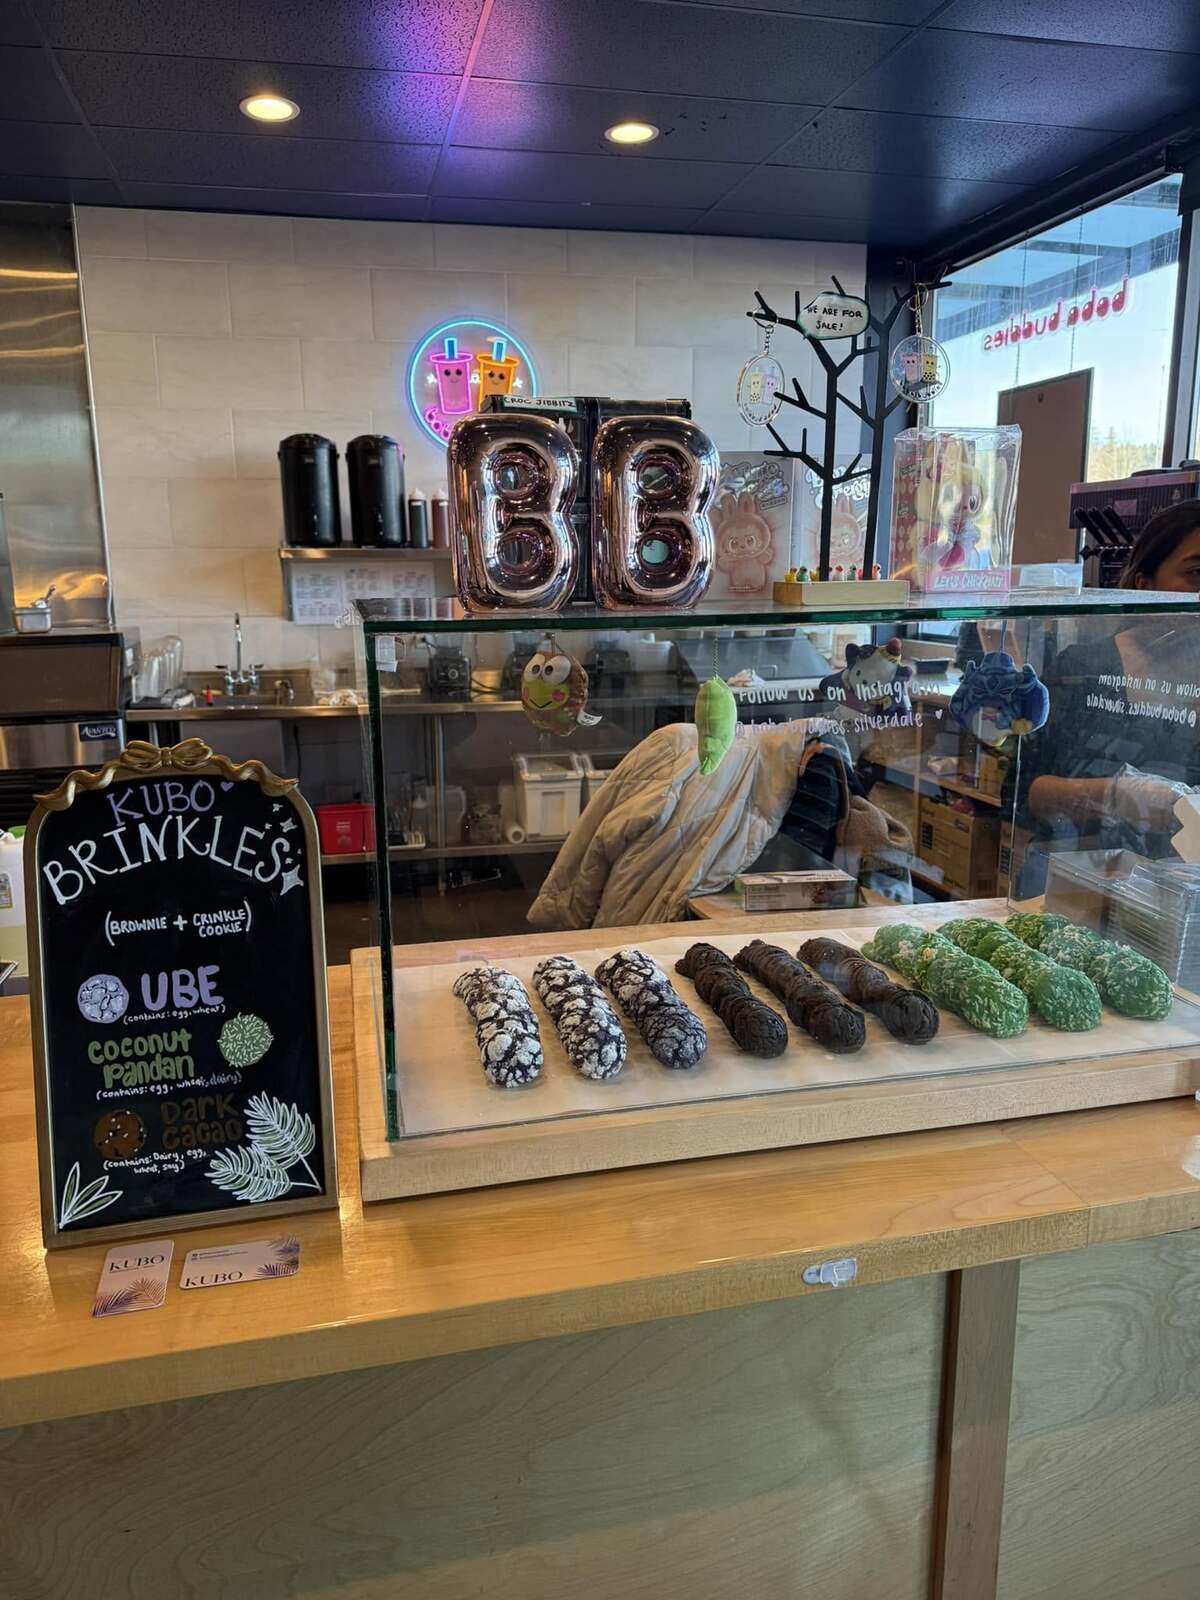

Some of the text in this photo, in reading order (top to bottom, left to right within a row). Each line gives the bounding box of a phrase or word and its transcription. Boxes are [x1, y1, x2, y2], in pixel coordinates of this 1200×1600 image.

[822, 307, 838, 316] ARE
[842, 309, 863, 318] FOR
[816, 320, 843, 331] SALE!
[739, 685, 788, 704] Follow
[827, 686, 846, 701] on
[107, 780, 215, 826] KUBO
[43, 815, 290, 904] BRINKLES
[105, 911, 167, 945] (BROWNIE
[173, 914, 188, 931] +
[141, 965, 224, 1011] UBE
[123, 1004, 226, 1025] (contains: egg, wheat)
[96, 1085, 148, 1100] (contains:
[149, 1083, 174, 1094] egg,
[209, 1071, 242, 1085] dairy)
[103, 1148, 207, 1170] (contains: Dairy, egg,
[134, 1166, 160, 1177] wheat,
[110, 1254, 165, 1271] KUBO
[185, 1271, 243, 1287] KUBO
